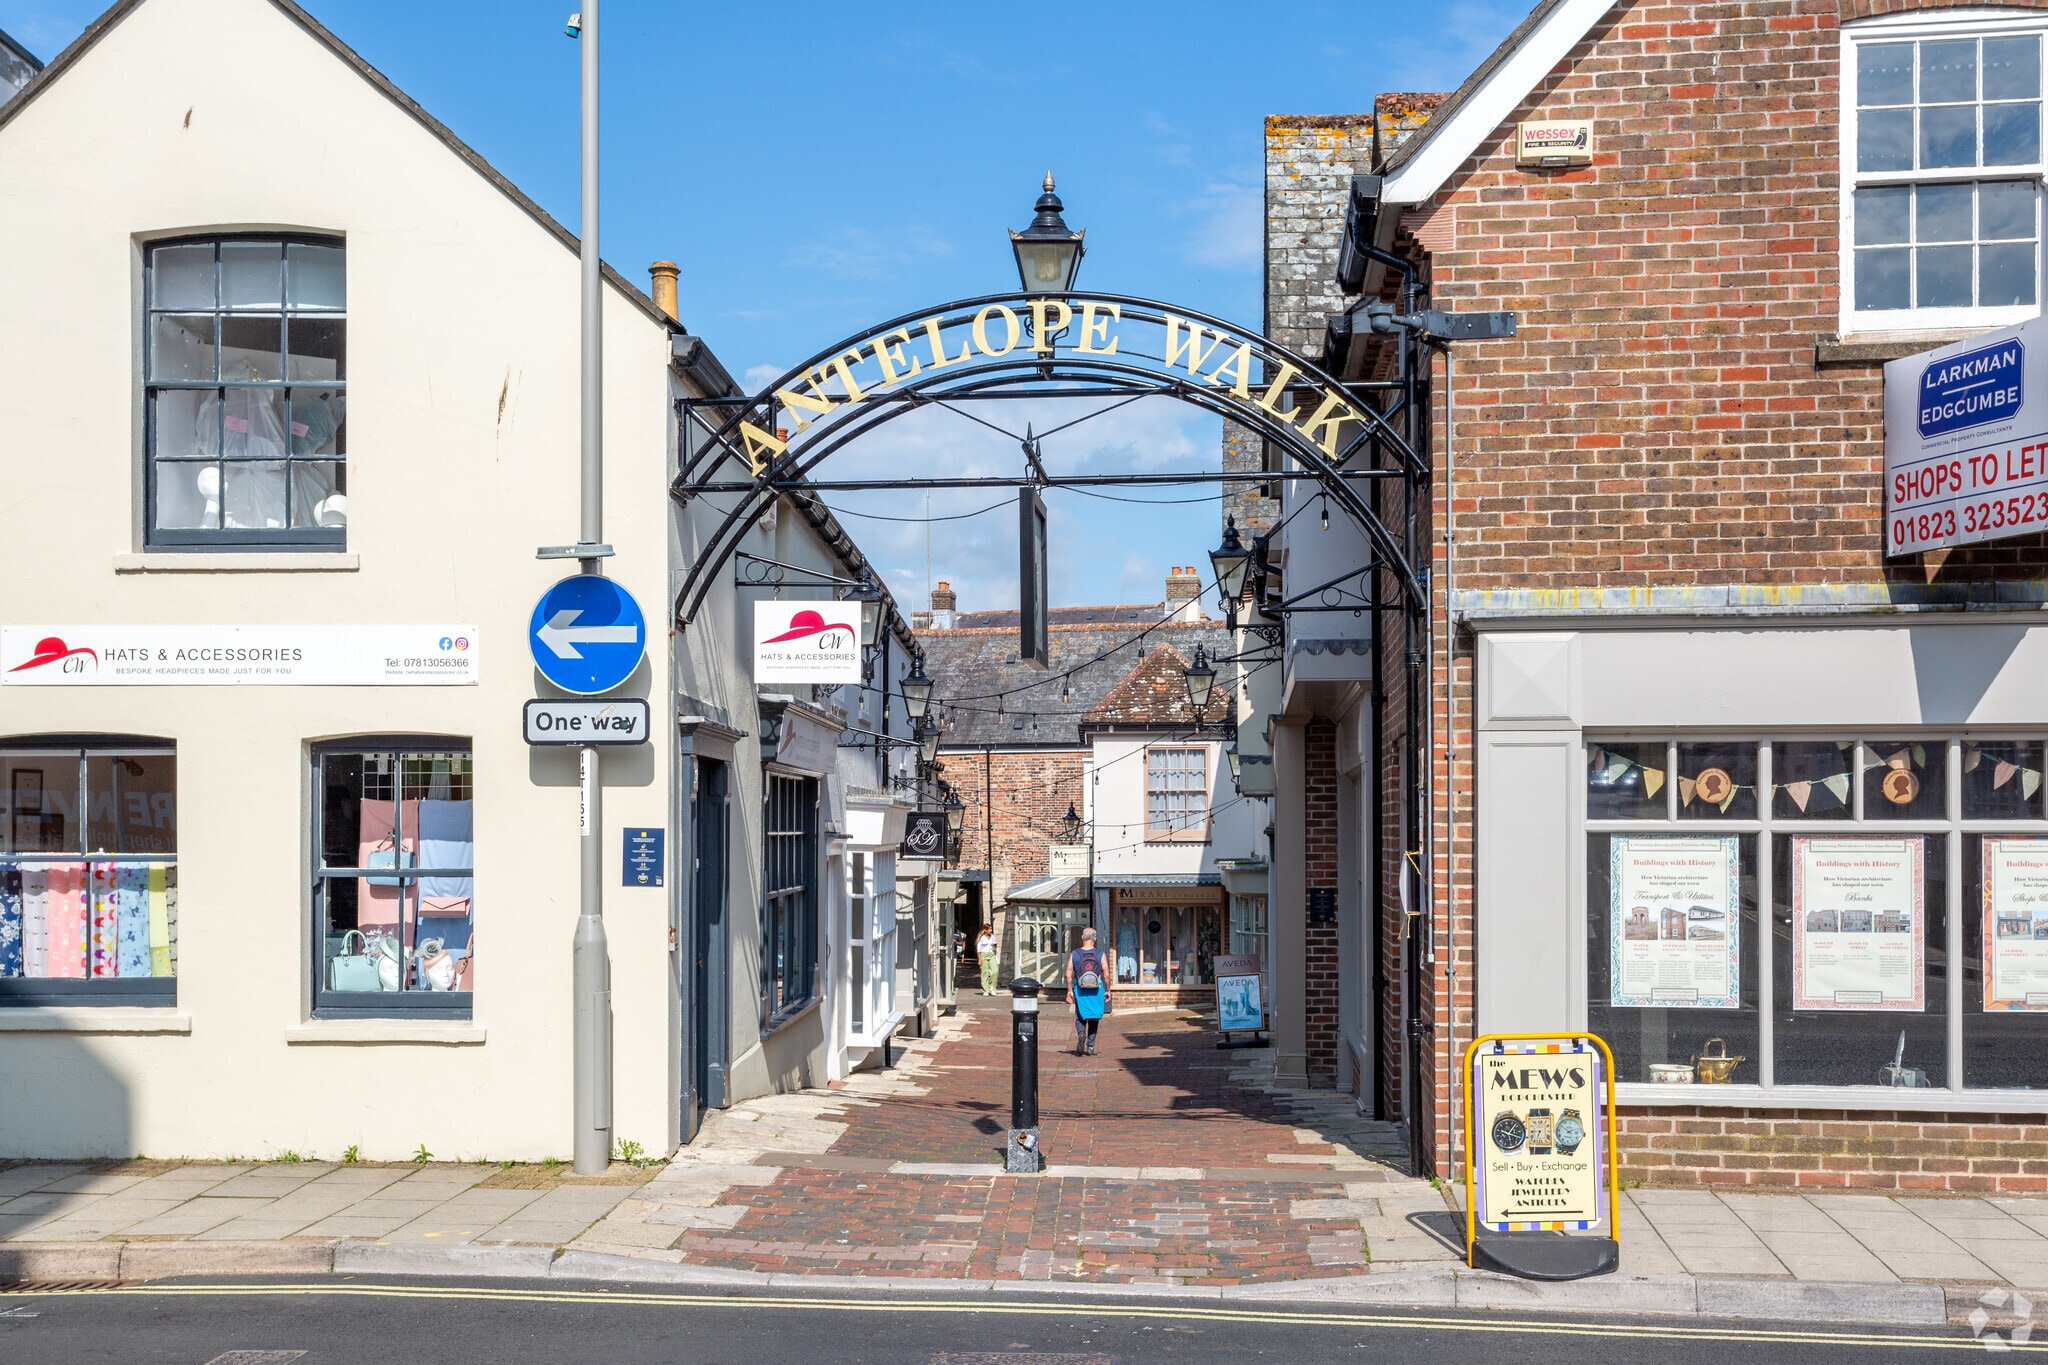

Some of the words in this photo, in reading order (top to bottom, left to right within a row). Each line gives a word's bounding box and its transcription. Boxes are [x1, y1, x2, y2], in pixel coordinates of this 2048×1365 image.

[1525, 128, 1576, 140] wessex
[1926, 349, 2016, 389] LARKMAN
[739, 300, 1120, 477] ANTELOPE
[1164, 313, 1367, 460] WALK
[1921, 386, 2018, 425] EDGCUMBE
[1894, 460, 1962, 504] SHOPS
[1968, 453, 1998, 488] TO
[2006, 441, 2048, 481] LET
[1893, 509, 1957, 545] 01823
[1963, 491, 2048, 533] 323523
[819, 632, 851, 650] CW
[104, 648, 149, 661] HATS
[157, 648, 169, 661] &
[175, 648, 303, 661] ACCESSORIES
[761, 653, 783, 661] HATS
[786, 653, 792, 661] &
[794, 653, 856, 661] ACCESSORIES
[63, 656, 93, 673] CW
[385, 658, 401, 667] Tel:
[404, 658, 469, 667] 07813056366
[116, 667, 152, 675] BESPOKE
[155, 667, 206, 675] HEADPIECES
[208, 667, 230, 675] MADE
[233, 667, 252, 675] JUST
[256, 667, 272, 675] FOR
[275, 667, 292, 675] YOU
[535, 711, 582, 731] One
[591, 716, 637, 734] way
[1633, 859, 1668, 867] Buildings
[1688, 859, 1716, 868] History
[1816, 860, 1852, 868] Buildings
[1871, 860, 1900, 869] History
[2006, 860, 2043, 868] Buildings
[1633, 890, 1670, 902] Transport
[1671, 890, 1684, 900] &
[1684, 889, 1715, 900] Utilities
[1844, 891, 1873, 902] Banks
[2012, 892, 2036, 904] Shops
[1222, 959, 1253, 968] AVEDA
[1223, 979, 1255, 988] AVEDA
[1491, 1067, 1586, 1090] MEWS
[1501, 1093, 1576, 1102] DORCHESTER
[1492, 1162, 1509, 1172] Sell
[1516, 1161, 1533, 1173] Buy
[1541, 1160, 1588, 1172] Exchange
[1515, 1177, 1566, 1186] WATCHES
[1509, 1187, 1571, 1197] JEWELLERY
[1514, 1198, 1567, 1207] ANTIQUES
